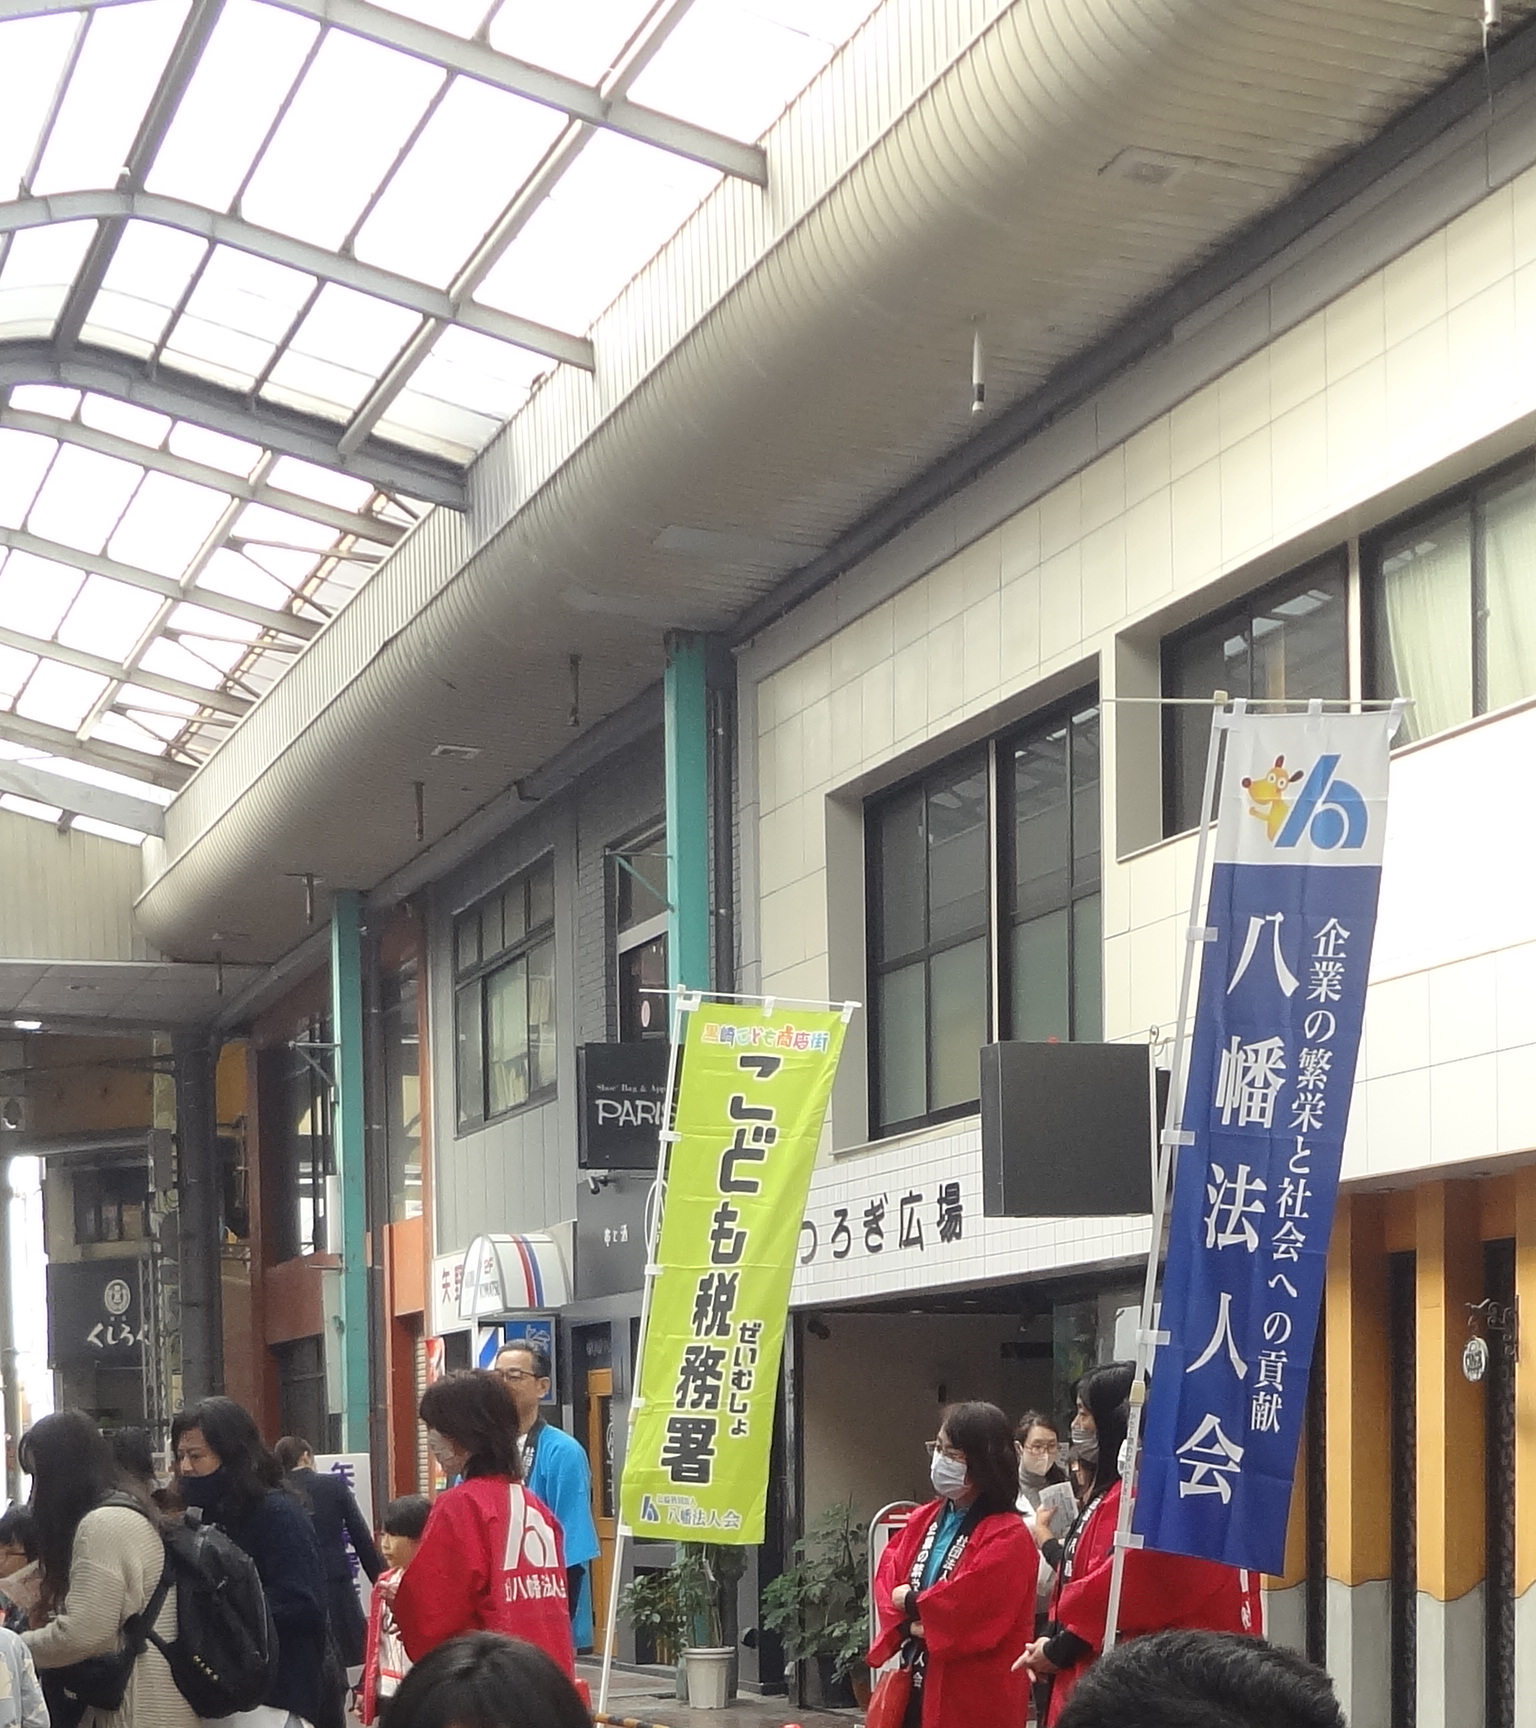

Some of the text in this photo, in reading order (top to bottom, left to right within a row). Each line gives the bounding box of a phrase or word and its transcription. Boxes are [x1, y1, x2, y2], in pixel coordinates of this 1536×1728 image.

[702, 1024, 829, 1051] 黒崎こども商店街
[1175, 911, 1301, 1505] 八幡法人会
[1250, 917, 1352, 1434] 企業の繁栄と社会への貢献
[660, 1055, 782, 1484] こども税務署
[728, 1321, 762, 1436] ぜいむしょ
